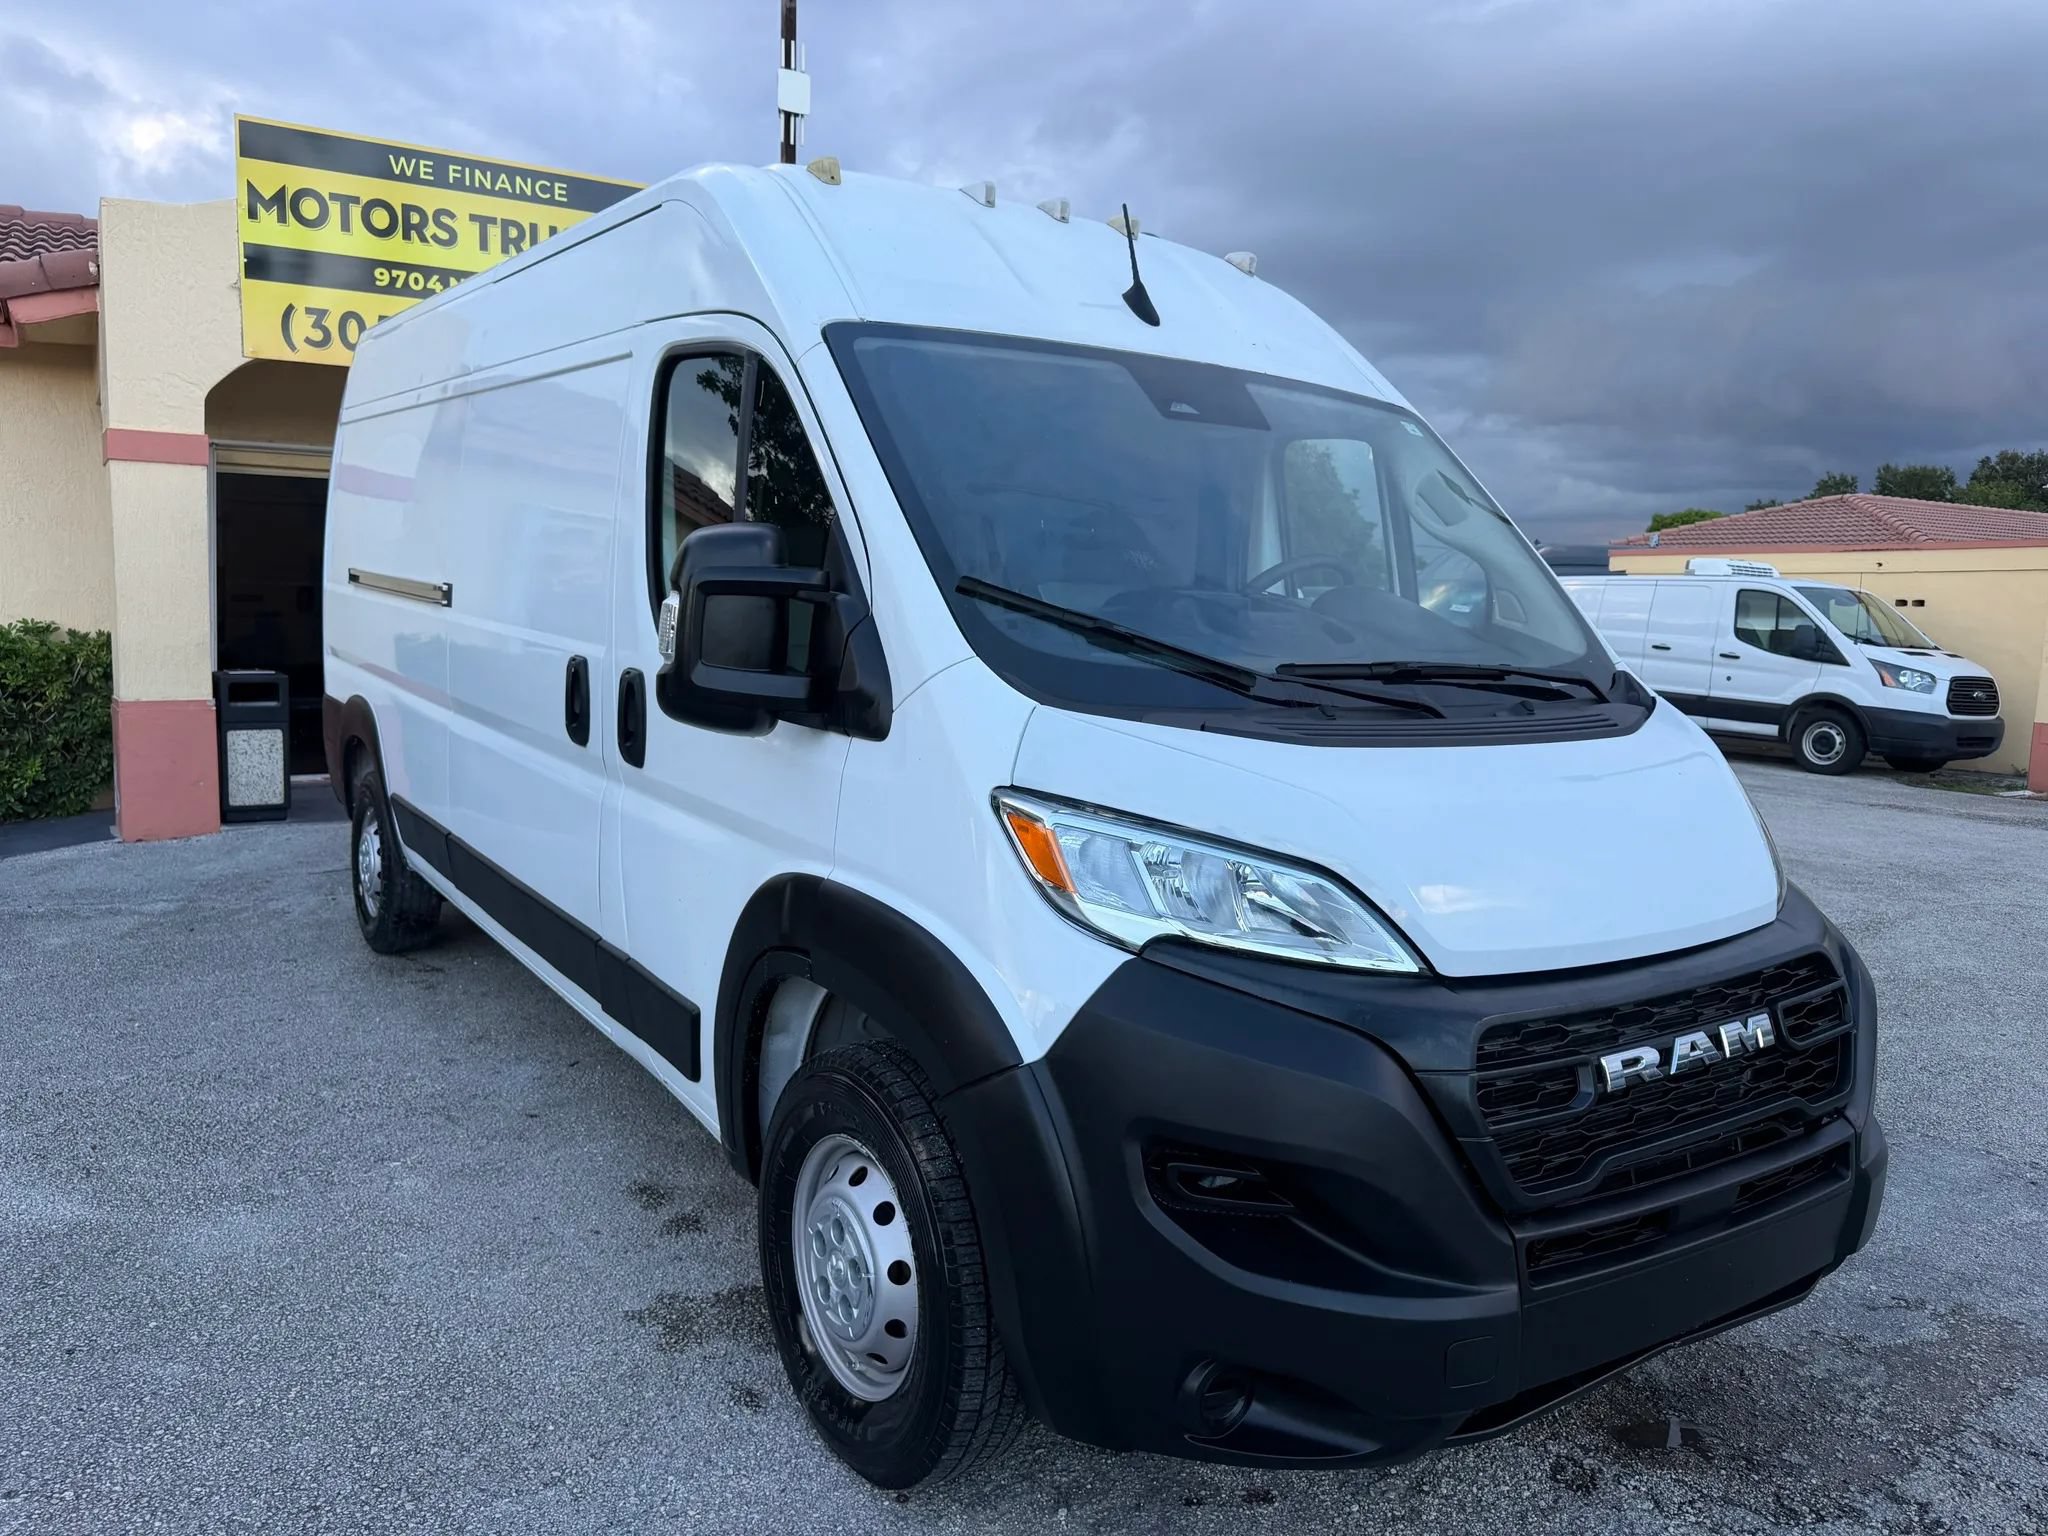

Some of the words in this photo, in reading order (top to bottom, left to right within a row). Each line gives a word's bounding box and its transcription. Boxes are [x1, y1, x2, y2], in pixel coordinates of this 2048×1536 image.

[388, 154, 434, 181] WE
[449, 165, 568, 202] FINANCE
[246, 178, 459, 249] MOTORS
[373, 267, 444, 294] 9704
[280, 302, 392, 354] (30
[1600, 1012, 1775, 1093] RAM
